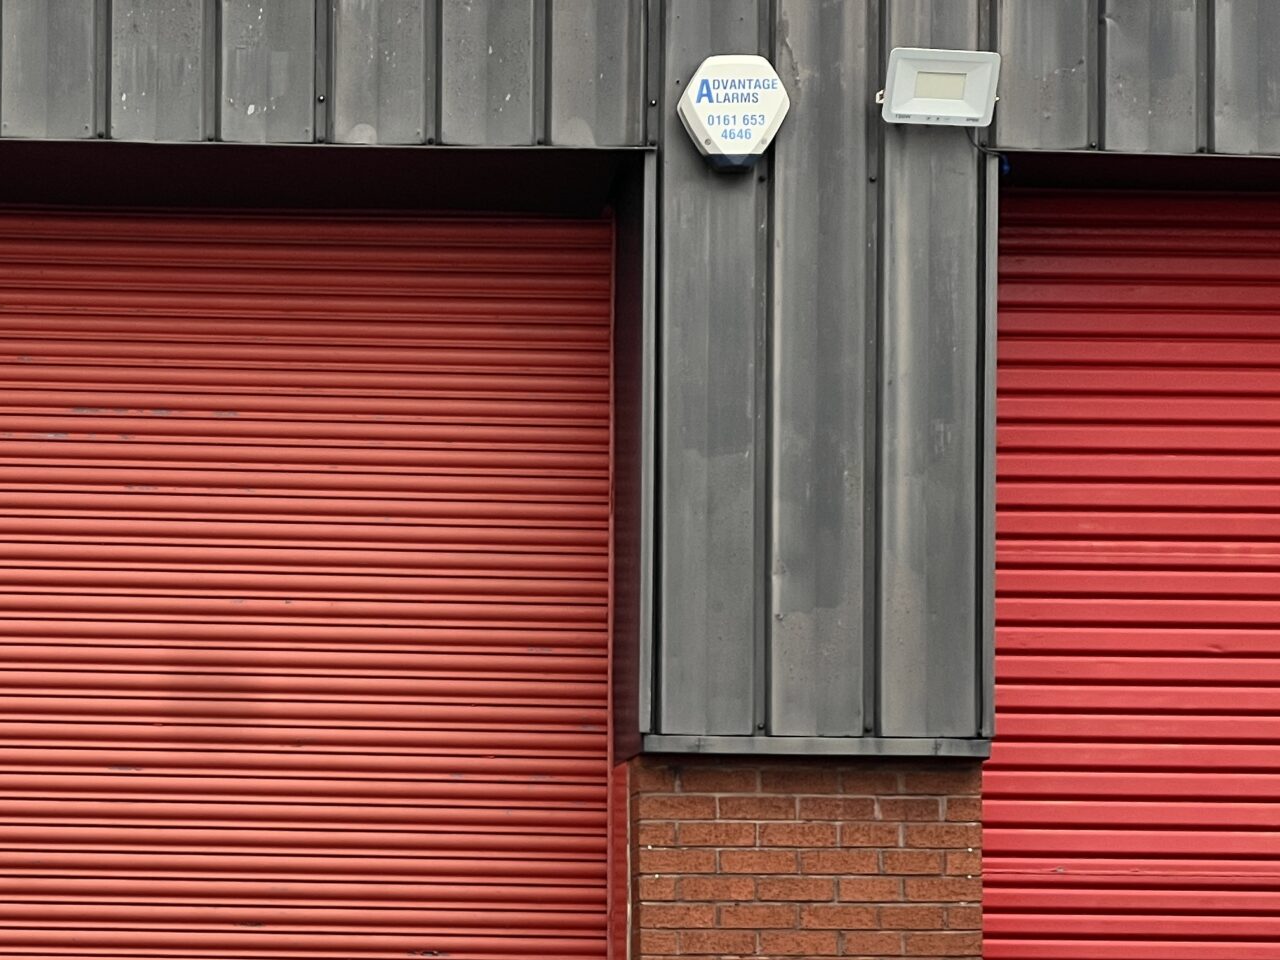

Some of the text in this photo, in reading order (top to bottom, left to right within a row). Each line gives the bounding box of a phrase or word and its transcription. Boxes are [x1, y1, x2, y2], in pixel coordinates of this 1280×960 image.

[696, 79, 778, 103] ADVANTAGE
[707, 114, 765, 126] 0161 653
[721, 128, 752, 140] 4646
